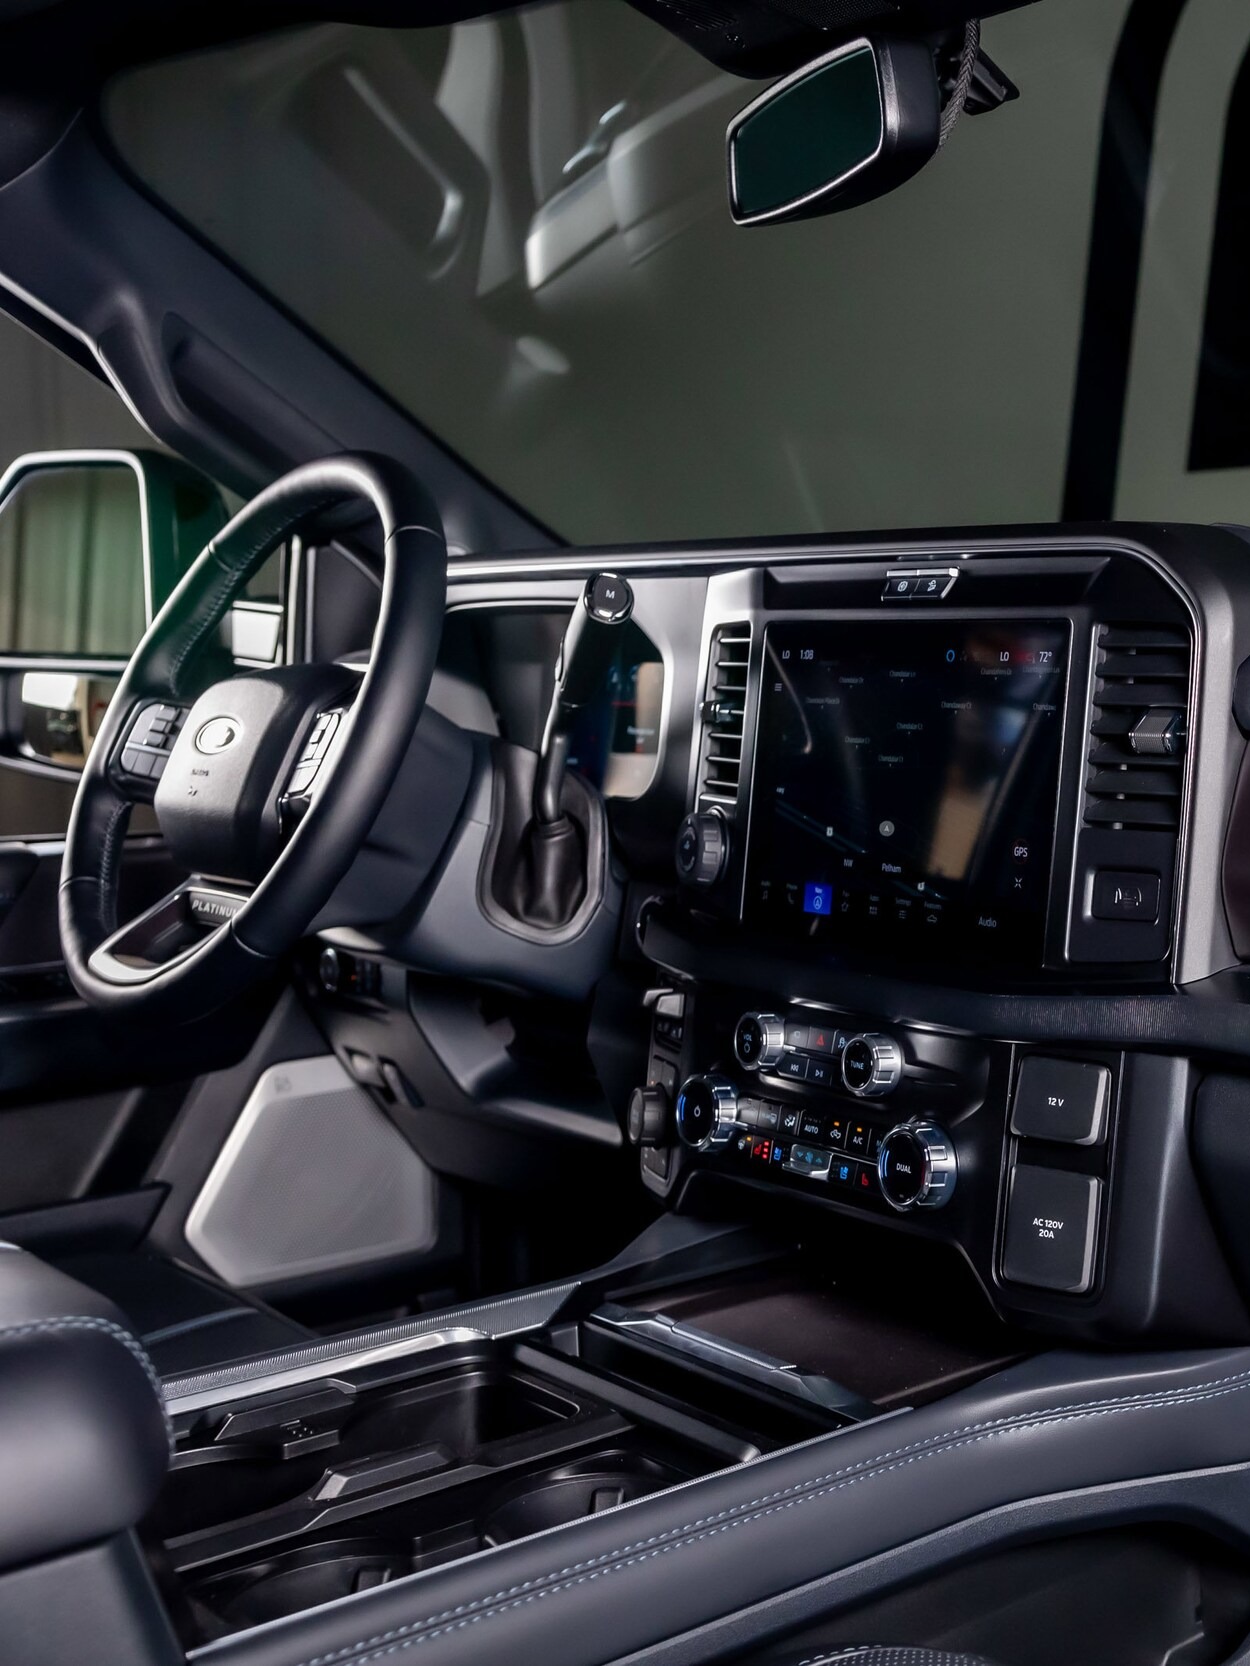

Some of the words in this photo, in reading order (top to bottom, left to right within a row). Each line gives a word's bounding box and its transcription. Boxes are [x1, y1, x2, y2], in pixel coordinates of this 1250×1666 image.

[605, 589, 615, 599] M
[1014, 847, 1028, 857] GPS
[978, 916, 997, 928] Audio
[850, 1060, 864, 1070] TUNE
[1048, 1097, 1057, 1106] 12
[1058, 1099, 1064, 1107] V
[804, 1125, 819, 1135] AUTO
[853, 1136, 863, 1145] A/C
[896, 1163, 912, 1174] DUAL
[1033, 1217, 1044, 1227] AC
[1045, 1219, 1064, 1230] 120V
[1038, 1229, 1055, 1239] 20A
